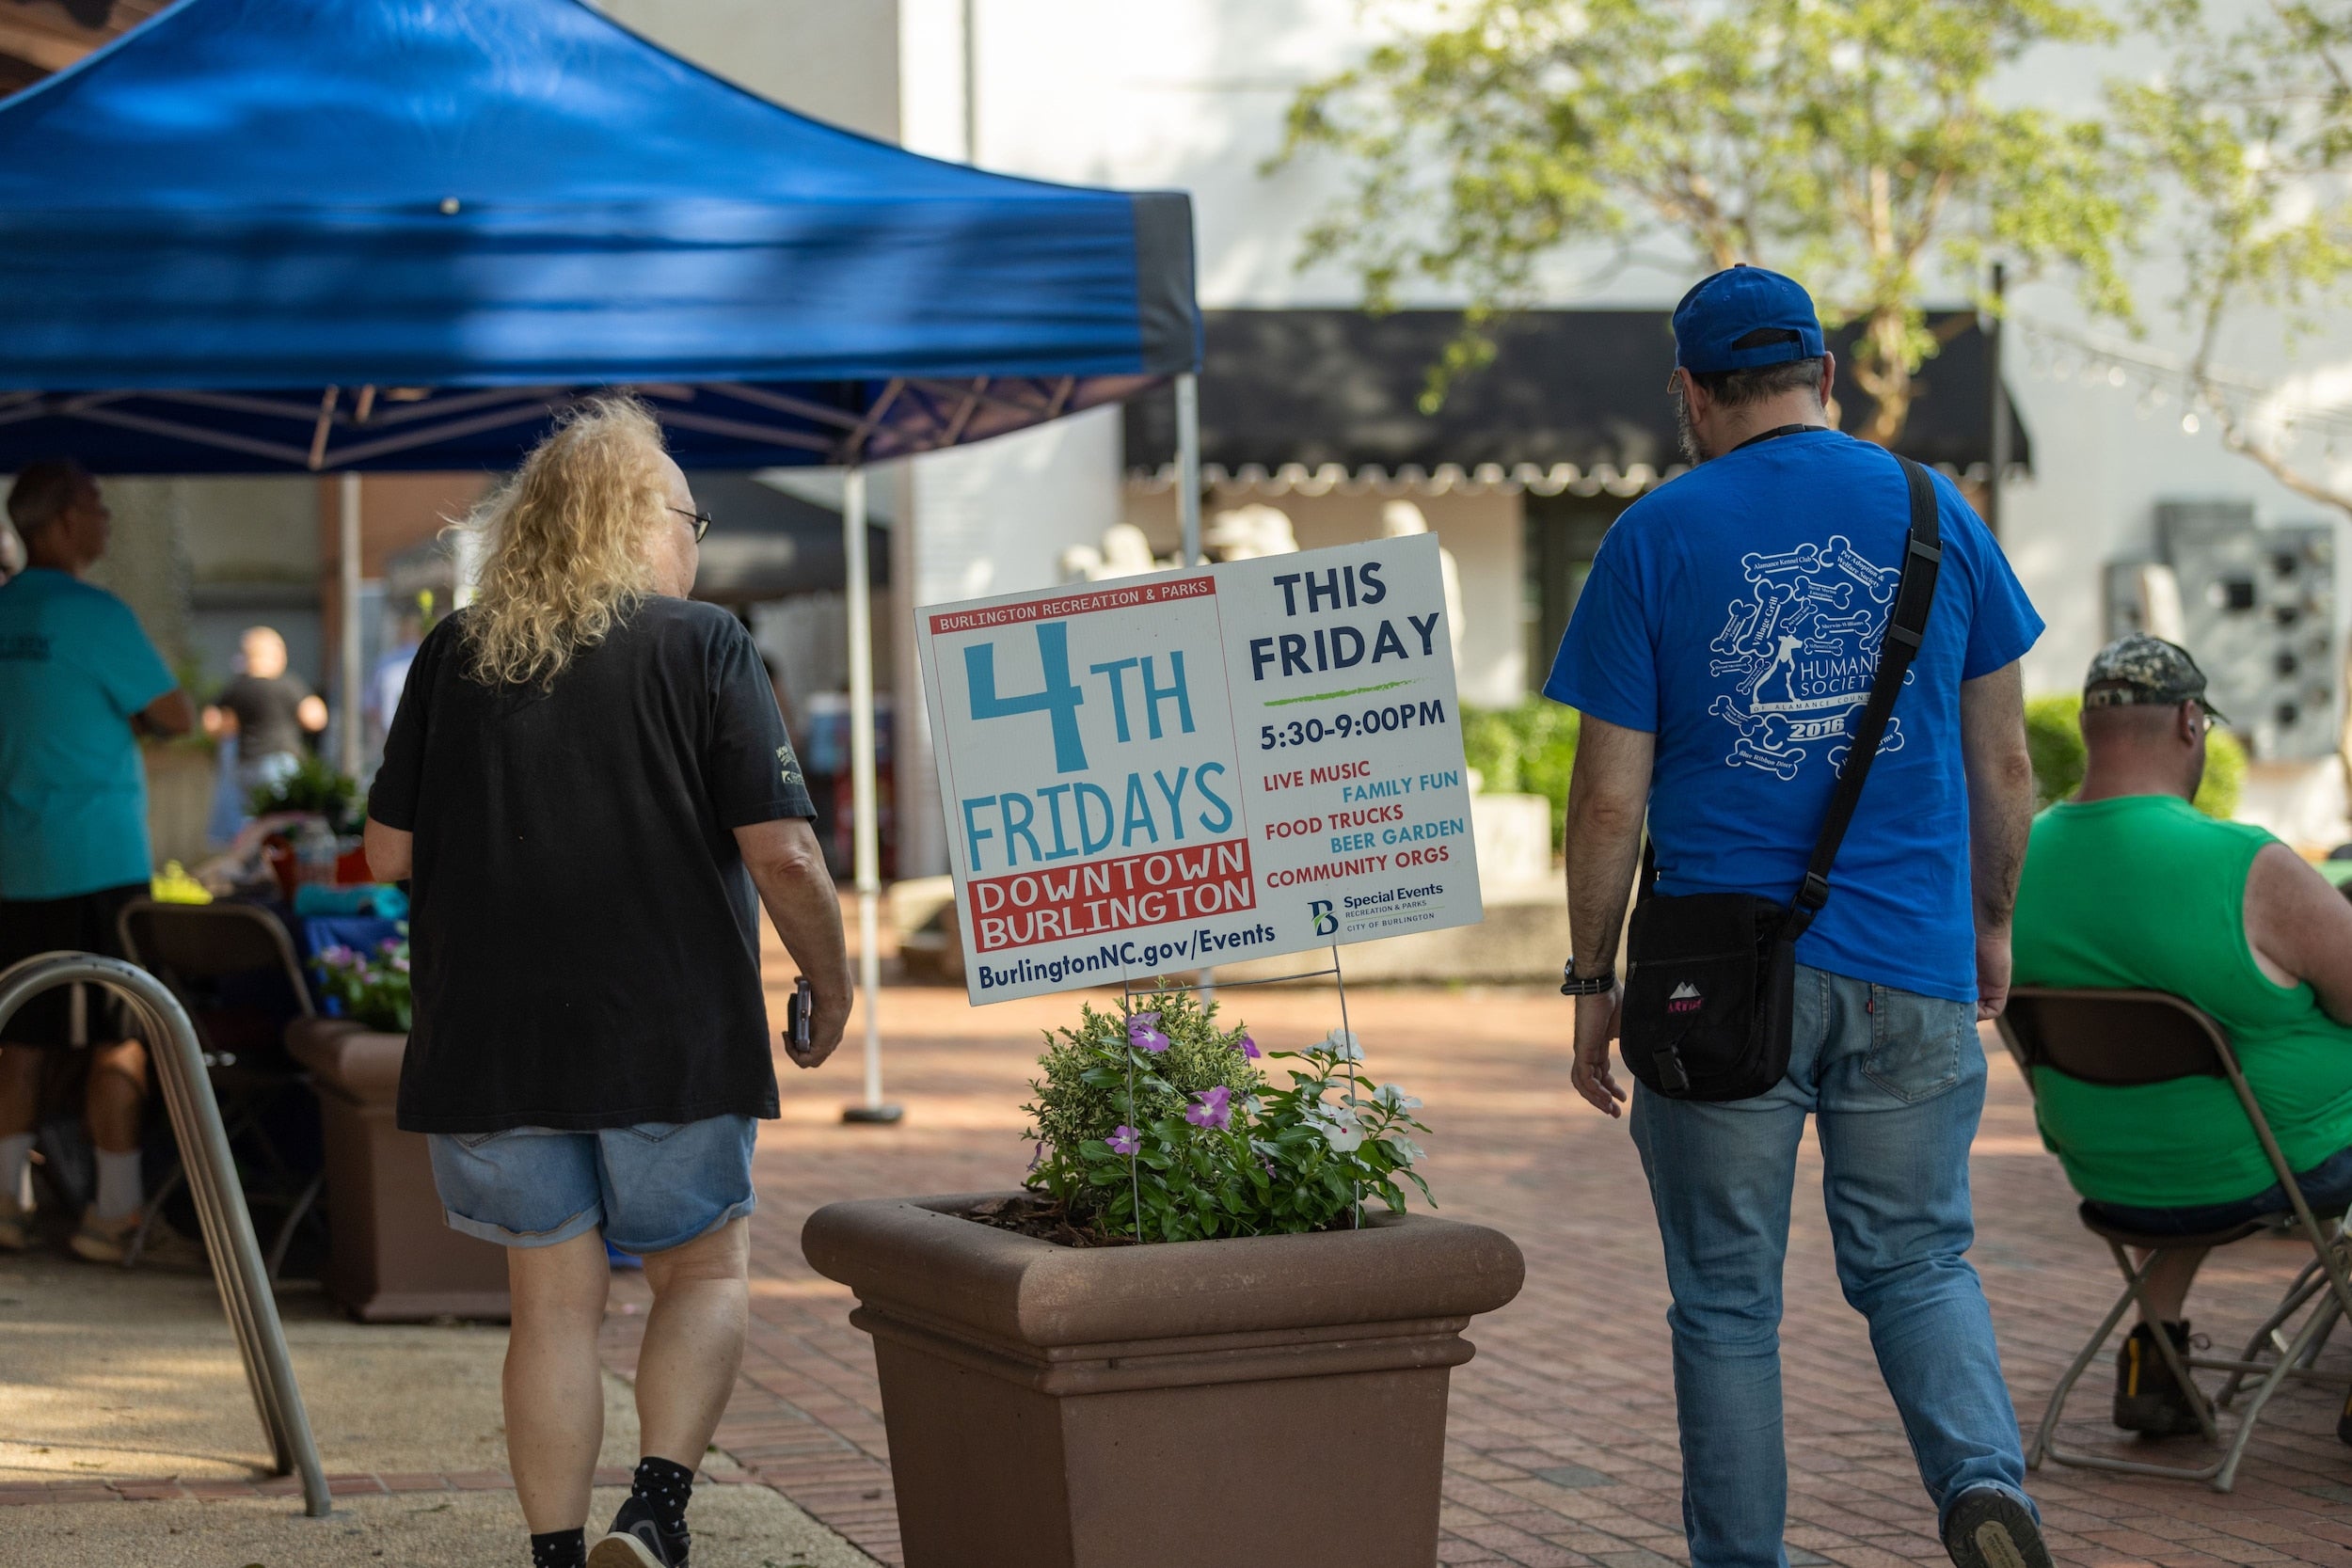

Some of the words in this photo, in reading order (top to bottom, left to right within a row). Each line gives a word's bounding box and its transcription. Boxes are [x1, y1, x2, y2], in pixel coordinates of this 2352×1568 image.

[1754, 561, 1780, 570] Alamance
[1779, 557, 1798, 565] Kennel
[1837, 556, 1859, 575] Welfare
[1859, 571, 1881, 588] Society
[1840, 550, 1851, 561] Pet
[1851, 558, 1878, 578] Adoption
[940, 606, 1037, 631] BURLINGTON
[1042, 590, 1139, 616] RECREATION
[1146, 589, 1155, 600] &
[1162, 580, 1208, 598] PARKS
[1273, 562, 1387, 616] THIS
[1752, 617, 1770, 645] Village
[1765, 596, 1779, 617] Grill
[1249, 612, 1440, 681] FRIDAY
[963, 621, 1196, 773] 4TH
[1801, 674, 1876, 696] SOCIET
[1774, 700, 1830, 710] ALAMANCE
[1261, 699, 1446, 750] 5:30-9:00PM
[1789, 719, 1845, 738] 2016
[1263, 771, 1304, 791] LIVE
[1311, 760, 1371, 784] MUSIC
[1753, 754, 1775, 768] Ribbon
[1775, 760, 1793, 768] Diner
[1343, 778, 1412, 802] FAMILY
[1420, 770, 1458, 791] FUN
[961, 762, 1233, 871] FRIDAYS
[1265, 817, 1323, 840] FOOD
[1328, 804, 1404, 830] TRUCKS
[1330, 832, 1375, 853] BEER
[1382, 817, 1464, 845] GARDEN
[977, 842, 1245, 914] DOWNTOWN
[1266, 854, 1388, 888] COMMUNITY
[1395, 846, 1449, 867] ORGS
[979, 878, 1250, 948] BURLINGTON
[1343, 889, 1394, 909] Special
[1397, 883, 1444, 900] Events
[1345, 905, 1393, 918] RECREATION
[1402, 900, 1427, 910] PARKS
[1382, 912, 1435, 927] BURLINGTON
[979, 924, 1276, 989] BurlingtonNC.gov/Events
